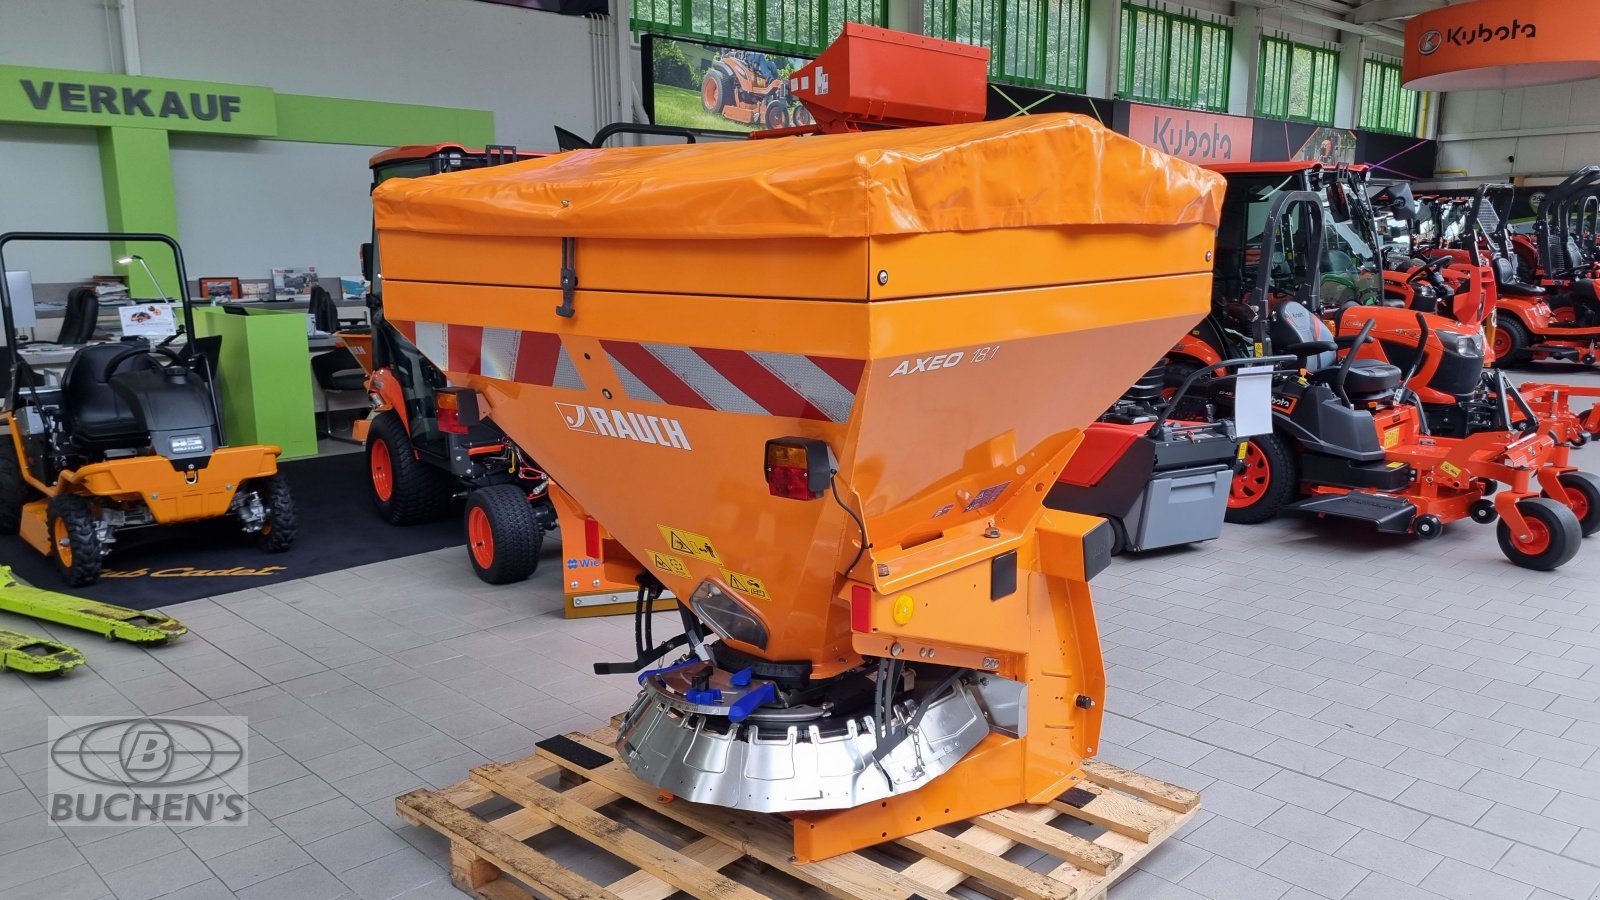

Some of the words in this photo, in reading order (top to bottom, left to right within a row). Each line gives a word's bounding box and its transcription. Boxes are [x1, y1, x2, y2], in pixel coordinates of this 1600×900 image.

[1446, 19, 1537, 46] Kubota
[19, 79, 241, 122] VERKAUF
[1153, 115, 1232, 160] Kubota
[888, 351, 965, 377] AXEO
[1271, 395, 1290, 408] bota
[587, 406, 692, 451] RAUCH
[100, 567, 149, 578] ub
[150, 566, 288, 577] Cadet
